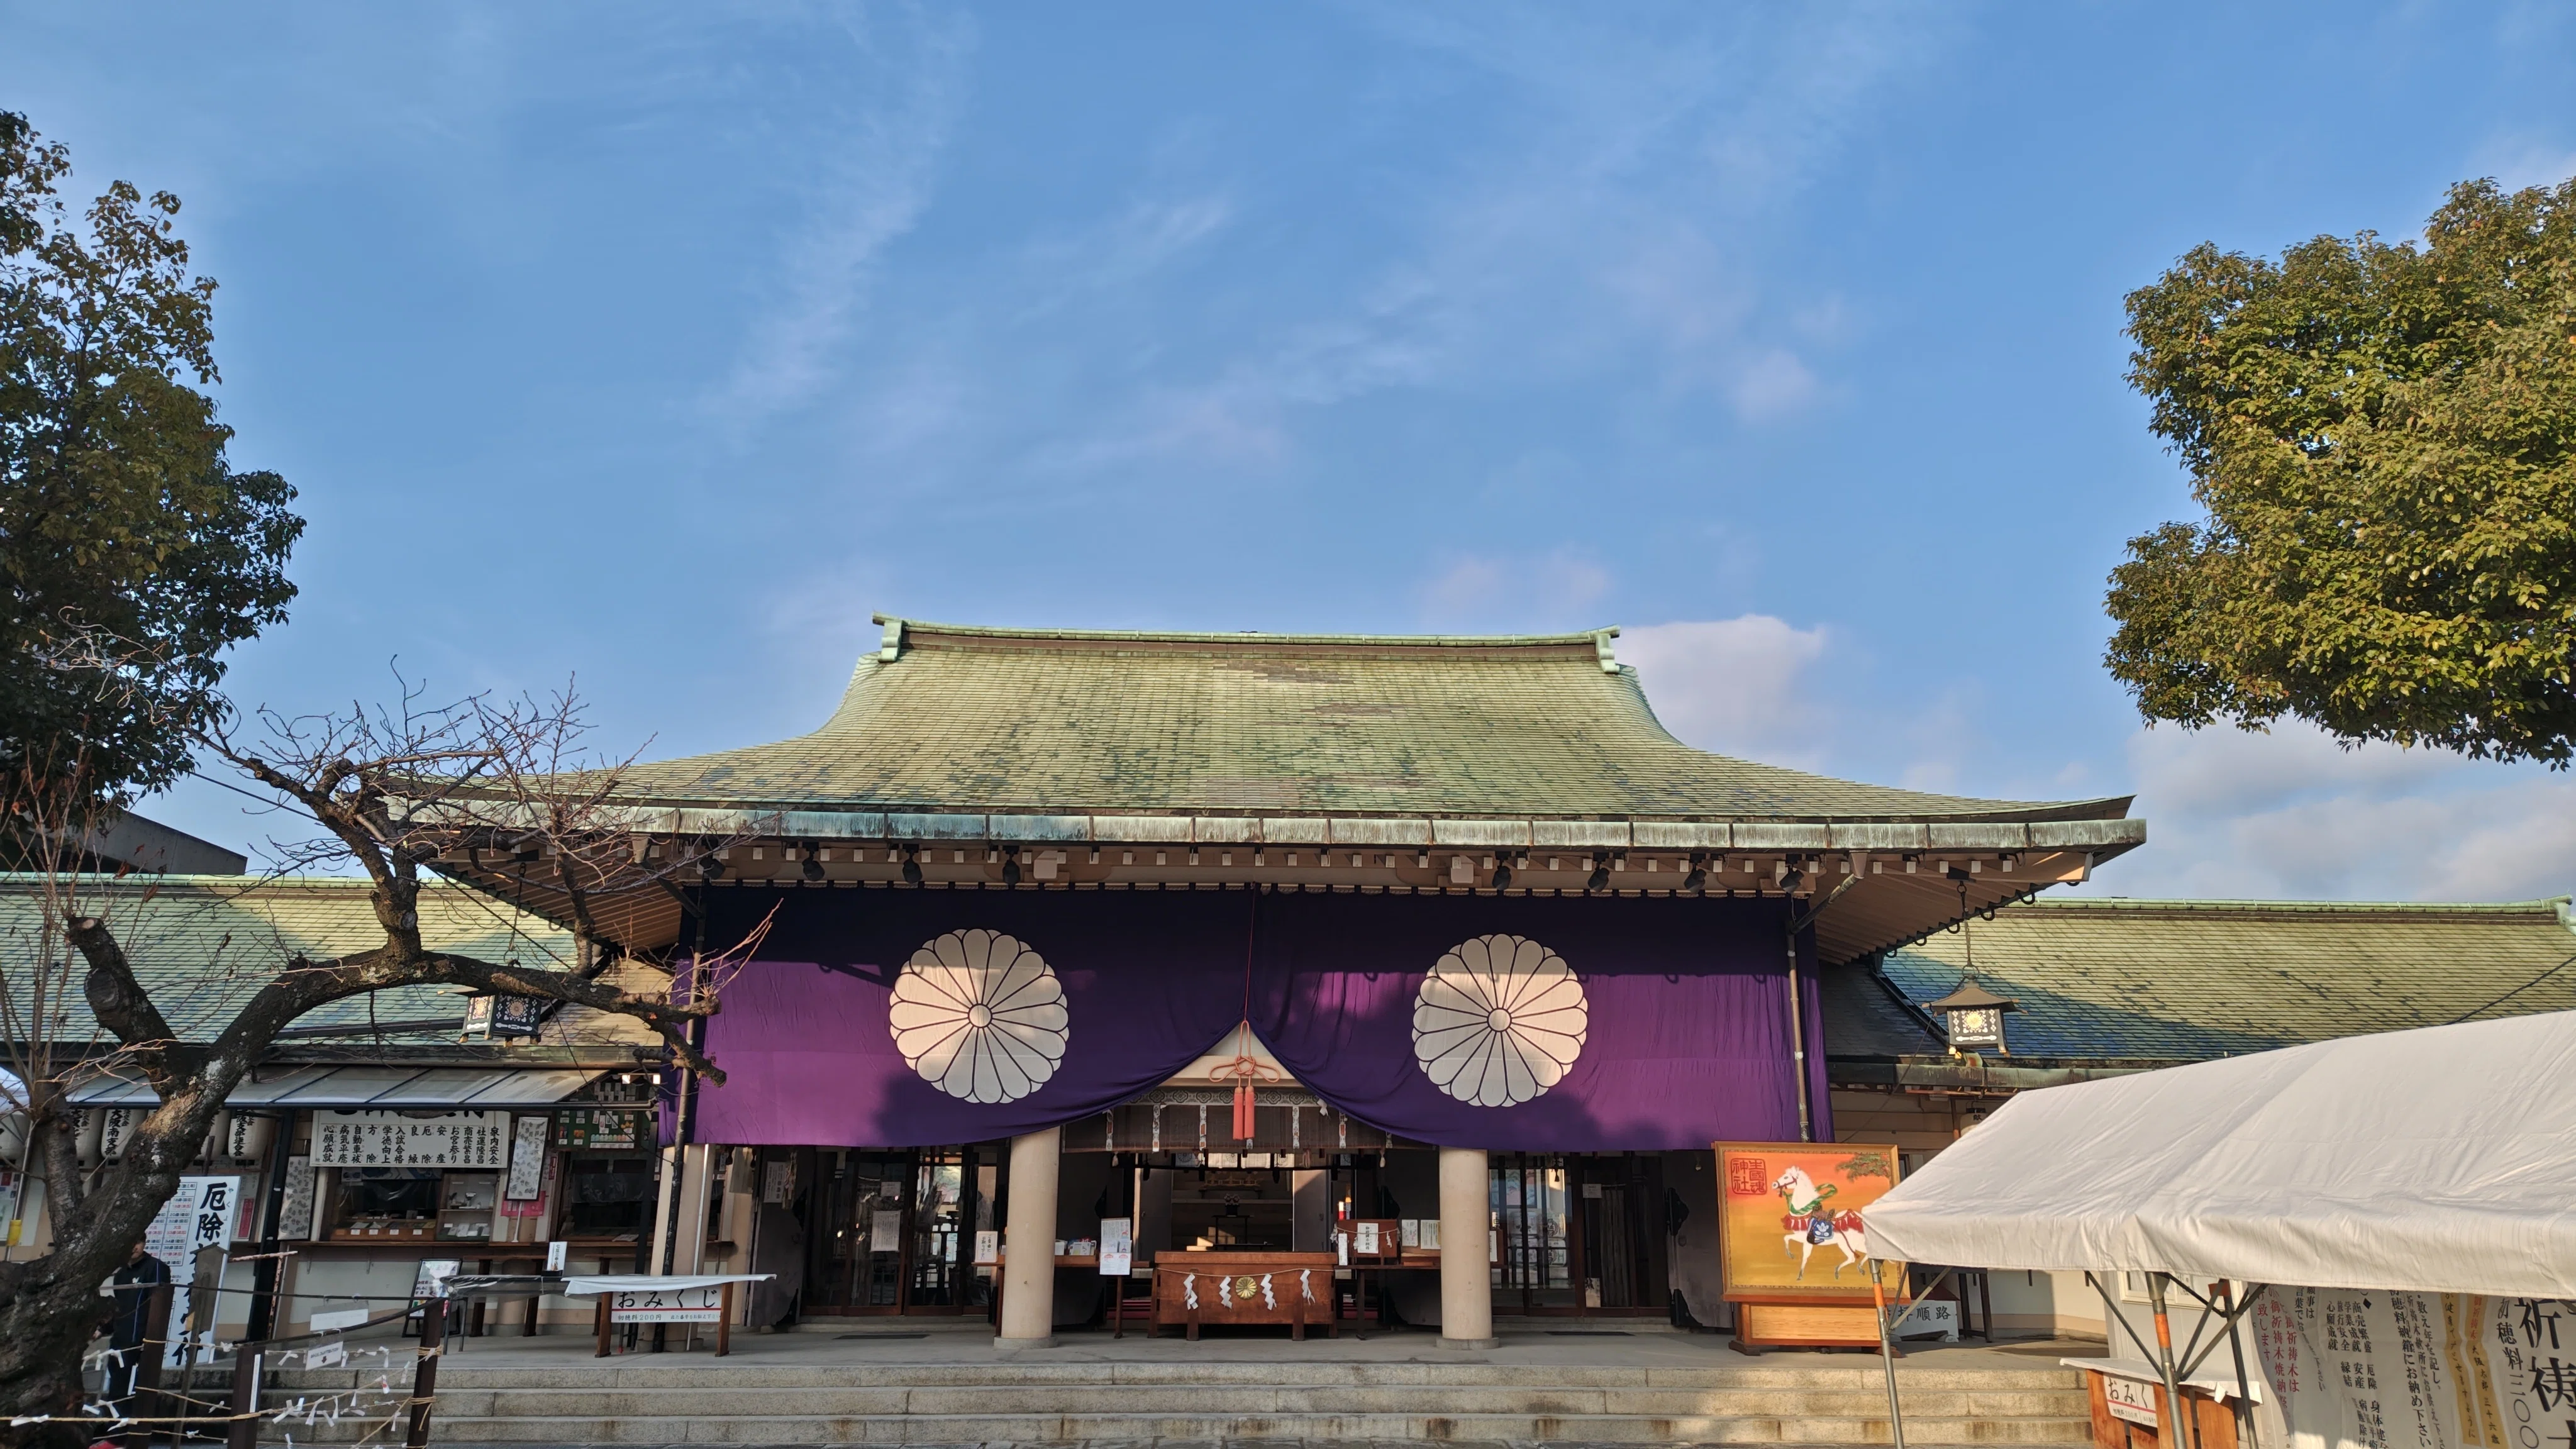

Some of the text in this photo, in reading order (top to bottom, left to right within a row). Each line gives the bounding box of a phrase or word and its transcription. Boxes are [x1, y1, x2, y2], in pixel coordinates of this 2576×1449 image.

[323, 1124, 335, 1163] 心願成就
[338, 1124, 350, 1163] 病気平癒
[351, 1124, 363, 1163] 自動車祓
[366, 1124, 377, 1163] 方除
[381, 1125, 393, 1163] 学徳向上
[394, 1126, 406, 1163] 入試合格
[408, 1125, 419, 1163] 良縁
[421, 1125, 432, 1163] 厄除
[436, 1125, 447, 1163] 安産
[448, 1126, 460, 1163] お宮参り
[476, 1126, 487, 1163] 社運隆昌
[488, 1126, 500, 1164] 家内安全
[618, 1289, 717, 1309] おみくじ
[2326, 1301, 2338, 1351] 心願成就
[2341, 1361, 2353, 1387] 縁結
[2353, 1362, 2365, 1389] 安産
[2367, 1364, 2377, 1390] 厄除
